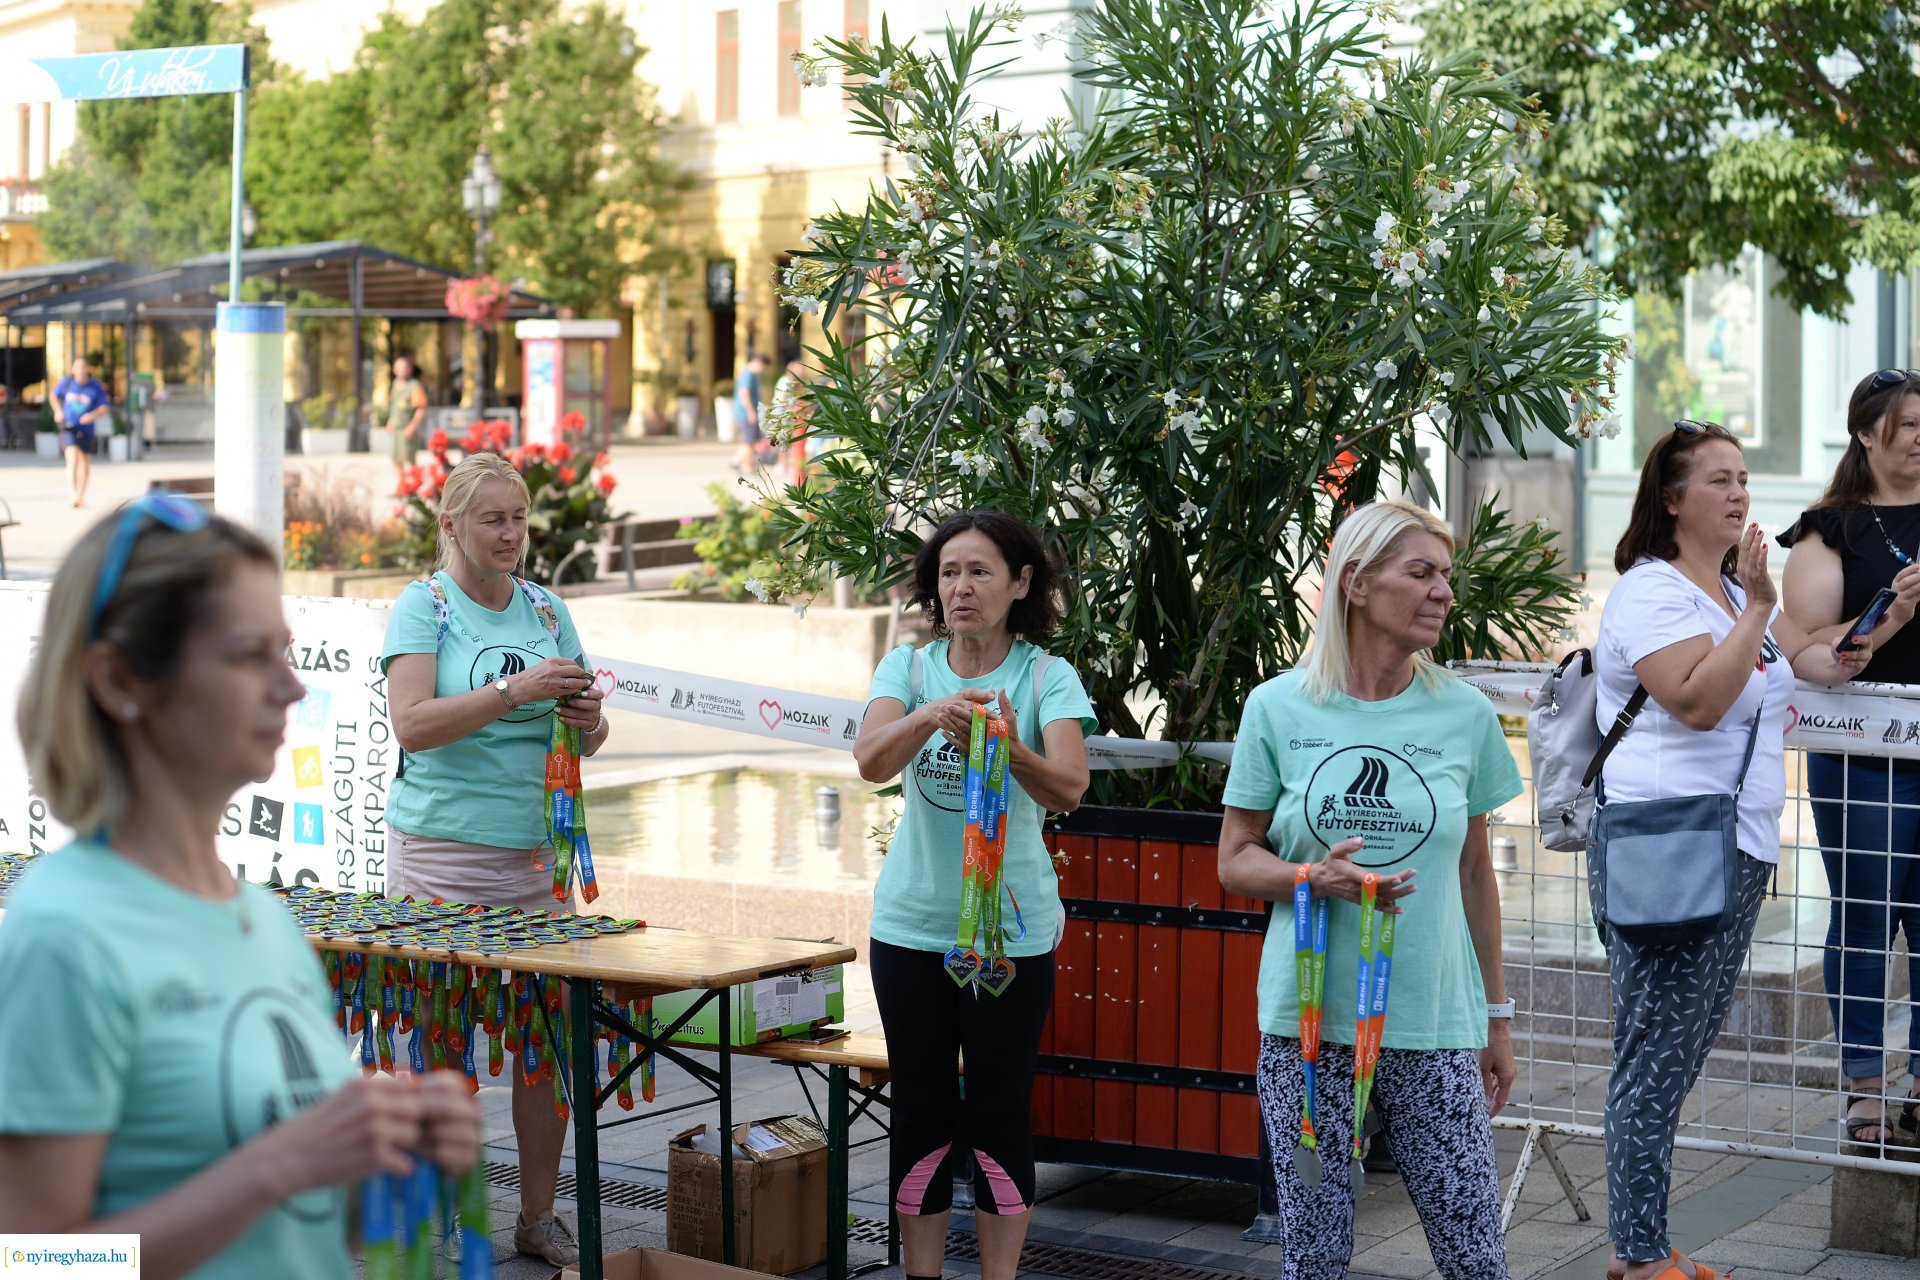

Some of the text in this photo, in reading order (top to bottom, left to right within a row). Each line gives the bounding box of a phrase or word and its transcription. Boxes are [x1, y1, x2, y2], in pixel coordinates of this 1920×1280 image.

[285, 638, 351, 673] ÁZÁS
[616, 679, 658, 697] MOZAIK
[699, 692, 742, 707] NYÍREGYHÁZI
[697, 701, 745, 717] FUTÓFESZTIVÁL
[783, 709, 830, 728] MOZAIK
[1799, 713, 1866, 732] MOZAIK
[1845, 730, 1865, 739] med
[1417, 746, 1442, 757] MOZAIK
[916, 767, 961, 782] FUTÓFES
[936, 762, 961, 772] NYÍREG
[329, 720, 358, 889] RSZÁGÚTI
[1345, 808, 1402, 819] NYÍREGYHÁZI
[1316, 818, 1425, 834] FUTÓFESZTIVÁL
